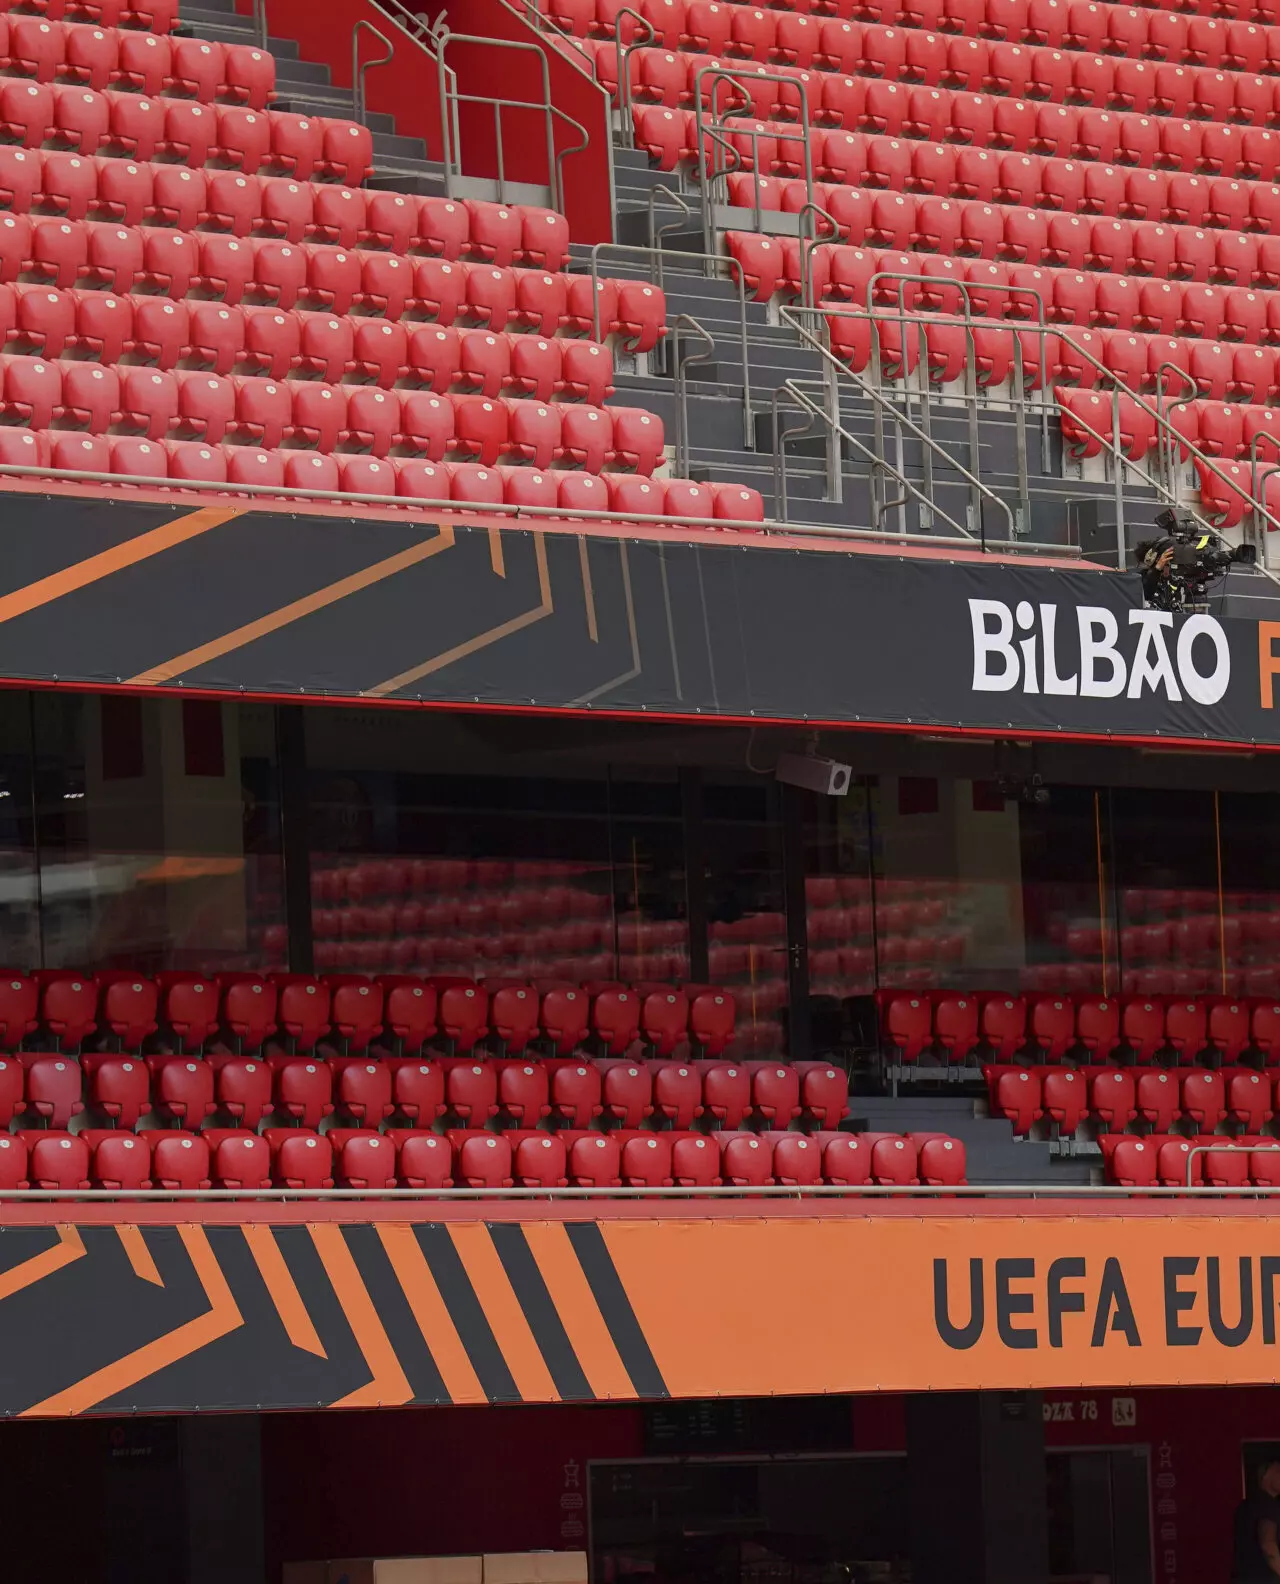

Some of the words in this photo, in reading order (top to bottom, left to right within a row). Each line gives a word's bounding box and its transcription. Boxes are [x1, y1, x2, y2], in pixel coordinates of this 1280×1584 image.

[394, 9, 451, 48] 26
[934, 1256, 1142, 1349] UEFA
[1042, 1401, 1075, 1421] OZA
[1080, 1400, 1098, 1420] 78
